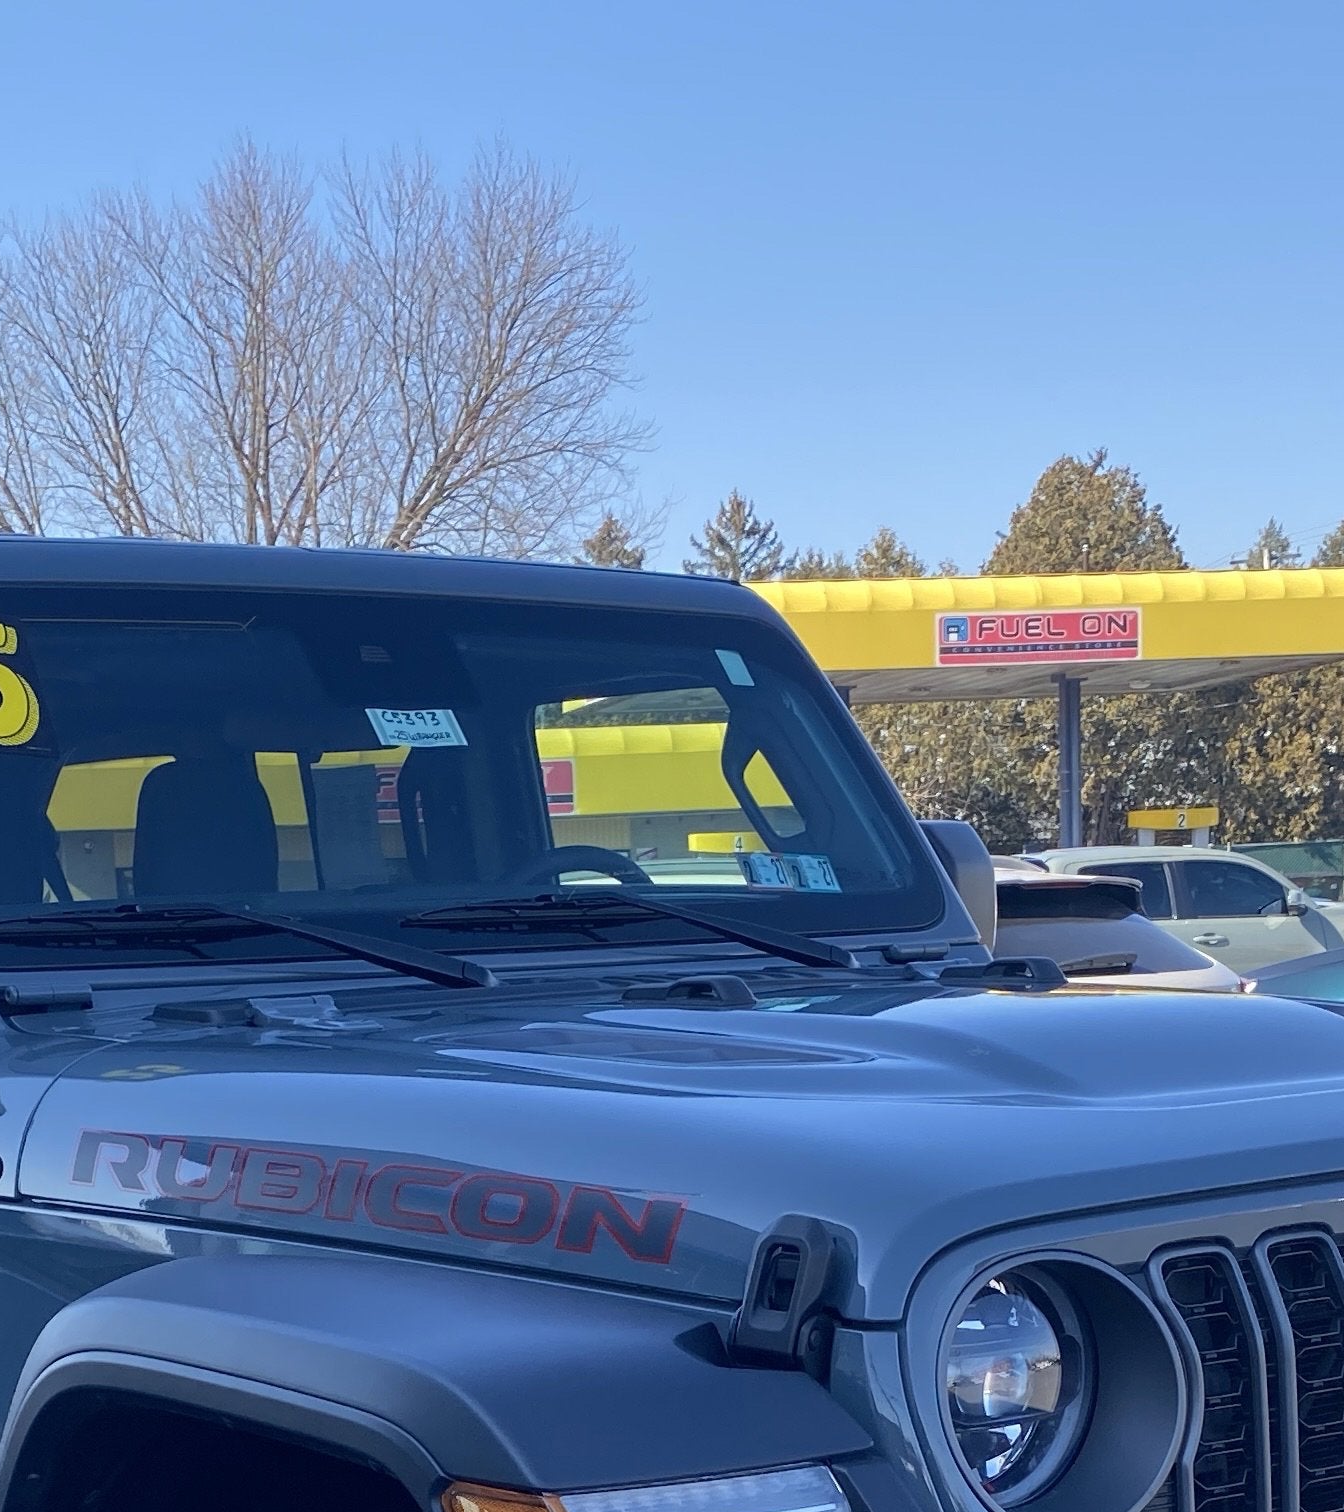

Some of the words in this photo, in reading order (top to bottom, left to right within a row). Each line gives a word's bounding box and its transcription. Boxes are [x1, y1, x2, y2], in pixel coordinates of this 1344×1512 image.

[976, 615, 1066, 639] FUEL
[1080, 613, 1129, 636] ON
[952, 643, 1065, 653] CONVENIENCE
[1074, 641, 1123, 651] STORE
[1177, 813, 1186, 828] 2
[735, 836, 743, 852] 4
[69, 1128, 690, 1265] RUBICON
